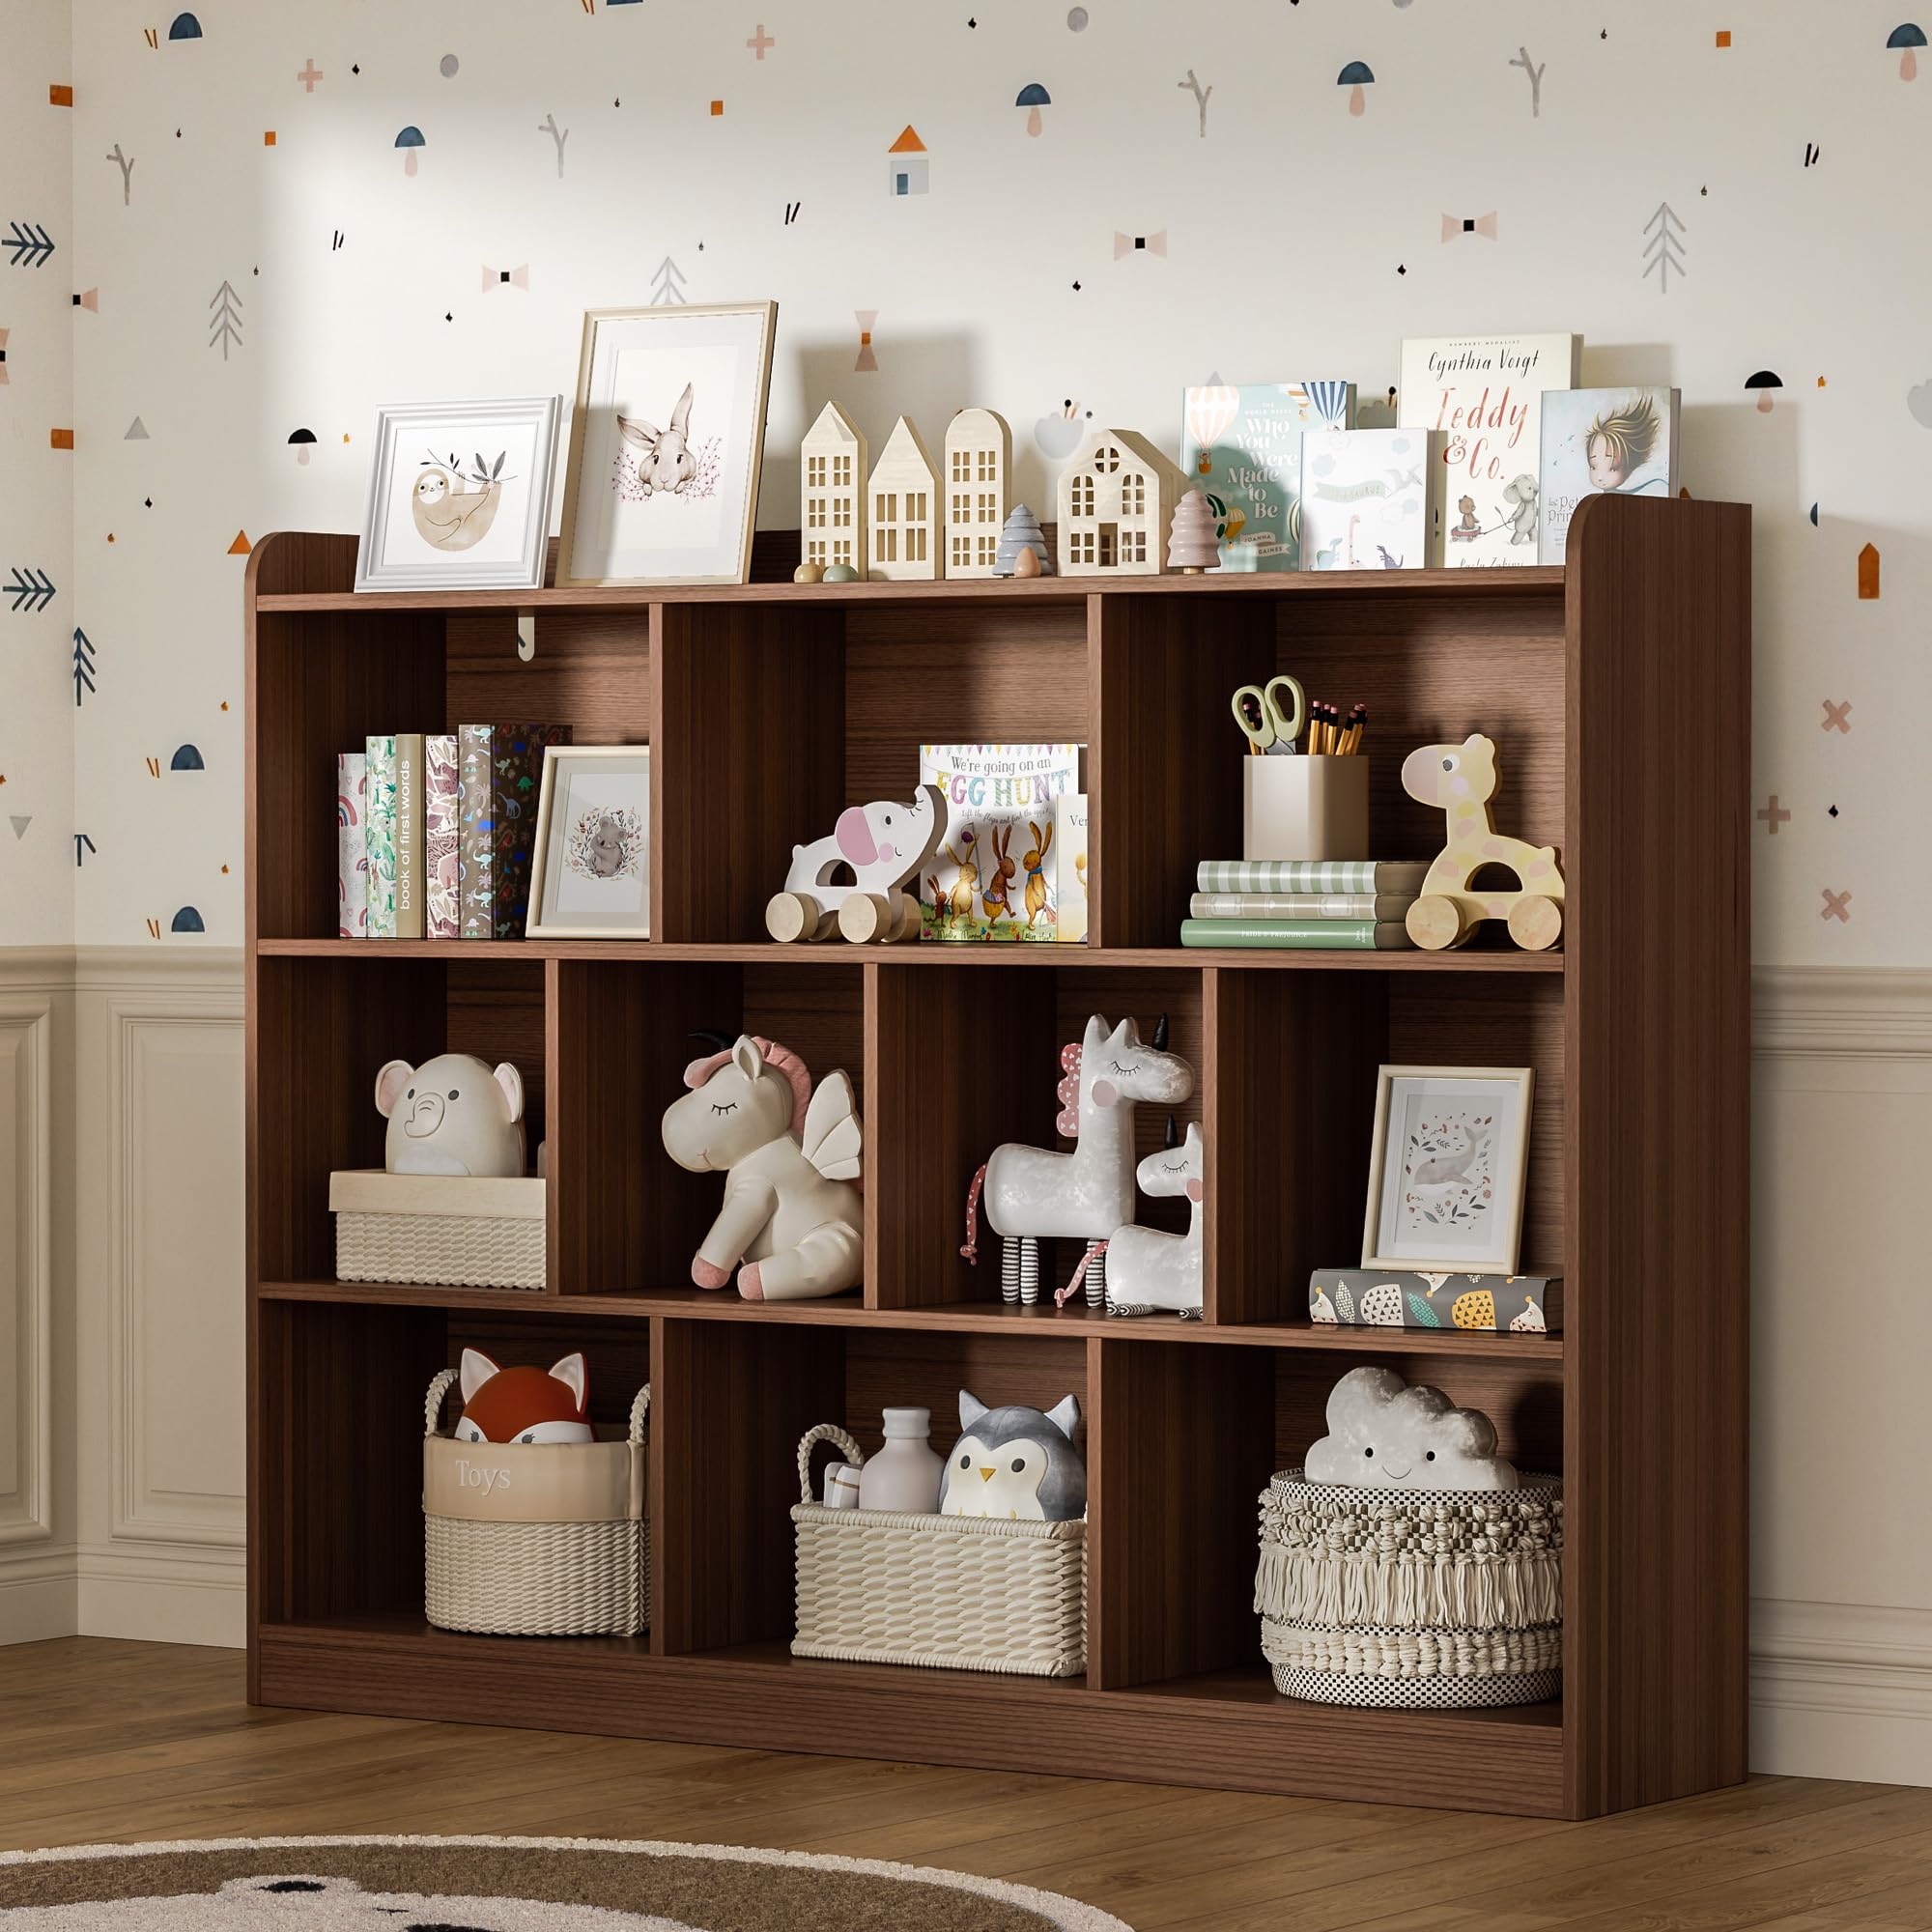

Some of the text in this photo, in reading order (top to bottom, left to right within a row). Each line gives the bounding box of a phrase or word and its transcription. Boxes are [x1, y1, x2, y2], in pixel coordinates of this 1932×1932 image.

[1429, 348, 1539, 382] Cynthia Voigt
[1246, 417, 1291, 440] Who
[1436, 386, 1528, 448] Teddy
[1236, 433, 1270, 449] You
[1250, 450, 1298, 468] Were
[1442, 435, 1505, 479] & Co.
[1227, 467, 1280, 490] Made
[1248, 485, 1267, 502] to
[1254, 502, 1279, 519] Be
[1243, 533, 1272, 543] JOANNA
[1258, 546, 1283, 555] GAINES
[952, 755, 1051, 776] We're going on an
[936, 769, 1070, 807] EGG HUNT
[400, 760, 411, 910] book of first words
[455, 1460, 511, 1497] Toys
